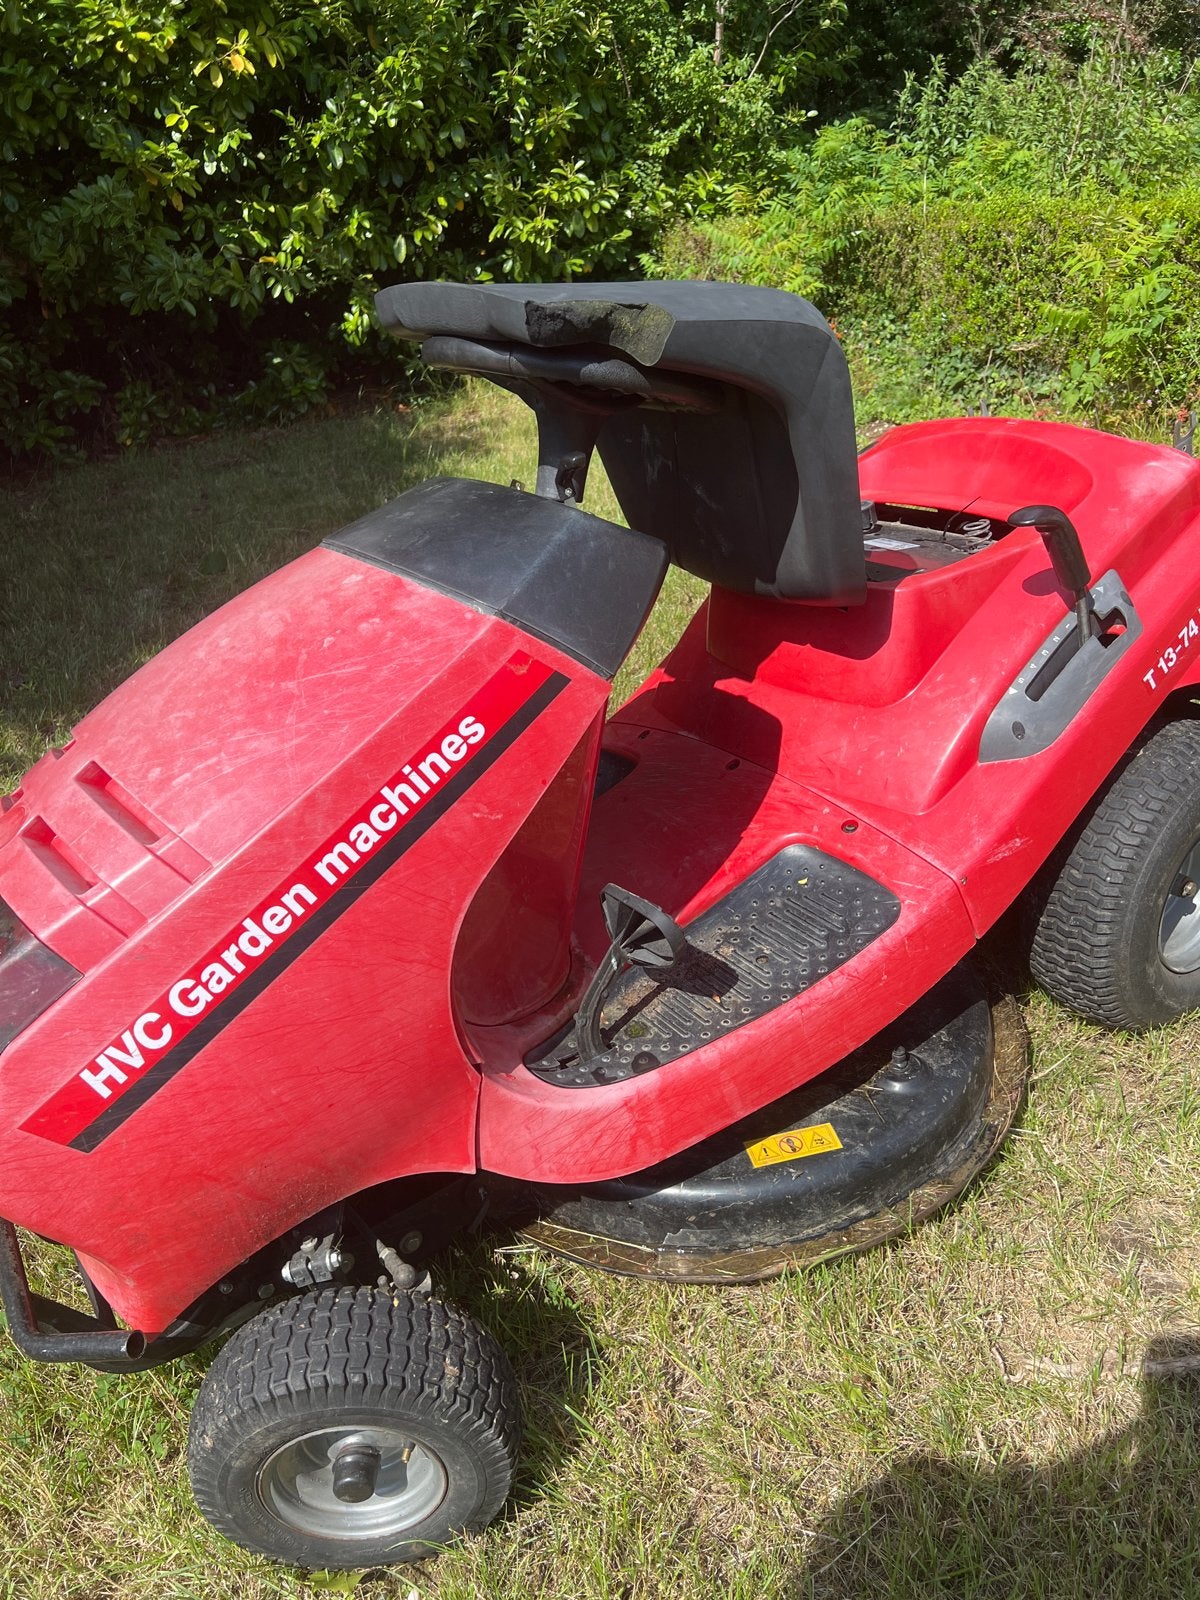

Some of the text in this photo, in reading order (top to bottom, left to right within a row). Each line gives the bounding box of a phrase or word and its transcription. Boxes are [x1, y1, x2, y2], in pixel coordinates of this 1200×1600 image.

[1142, 618, 1199, 690] T 13-74
[79, 716, 486, 1099] HVC Garden machines
